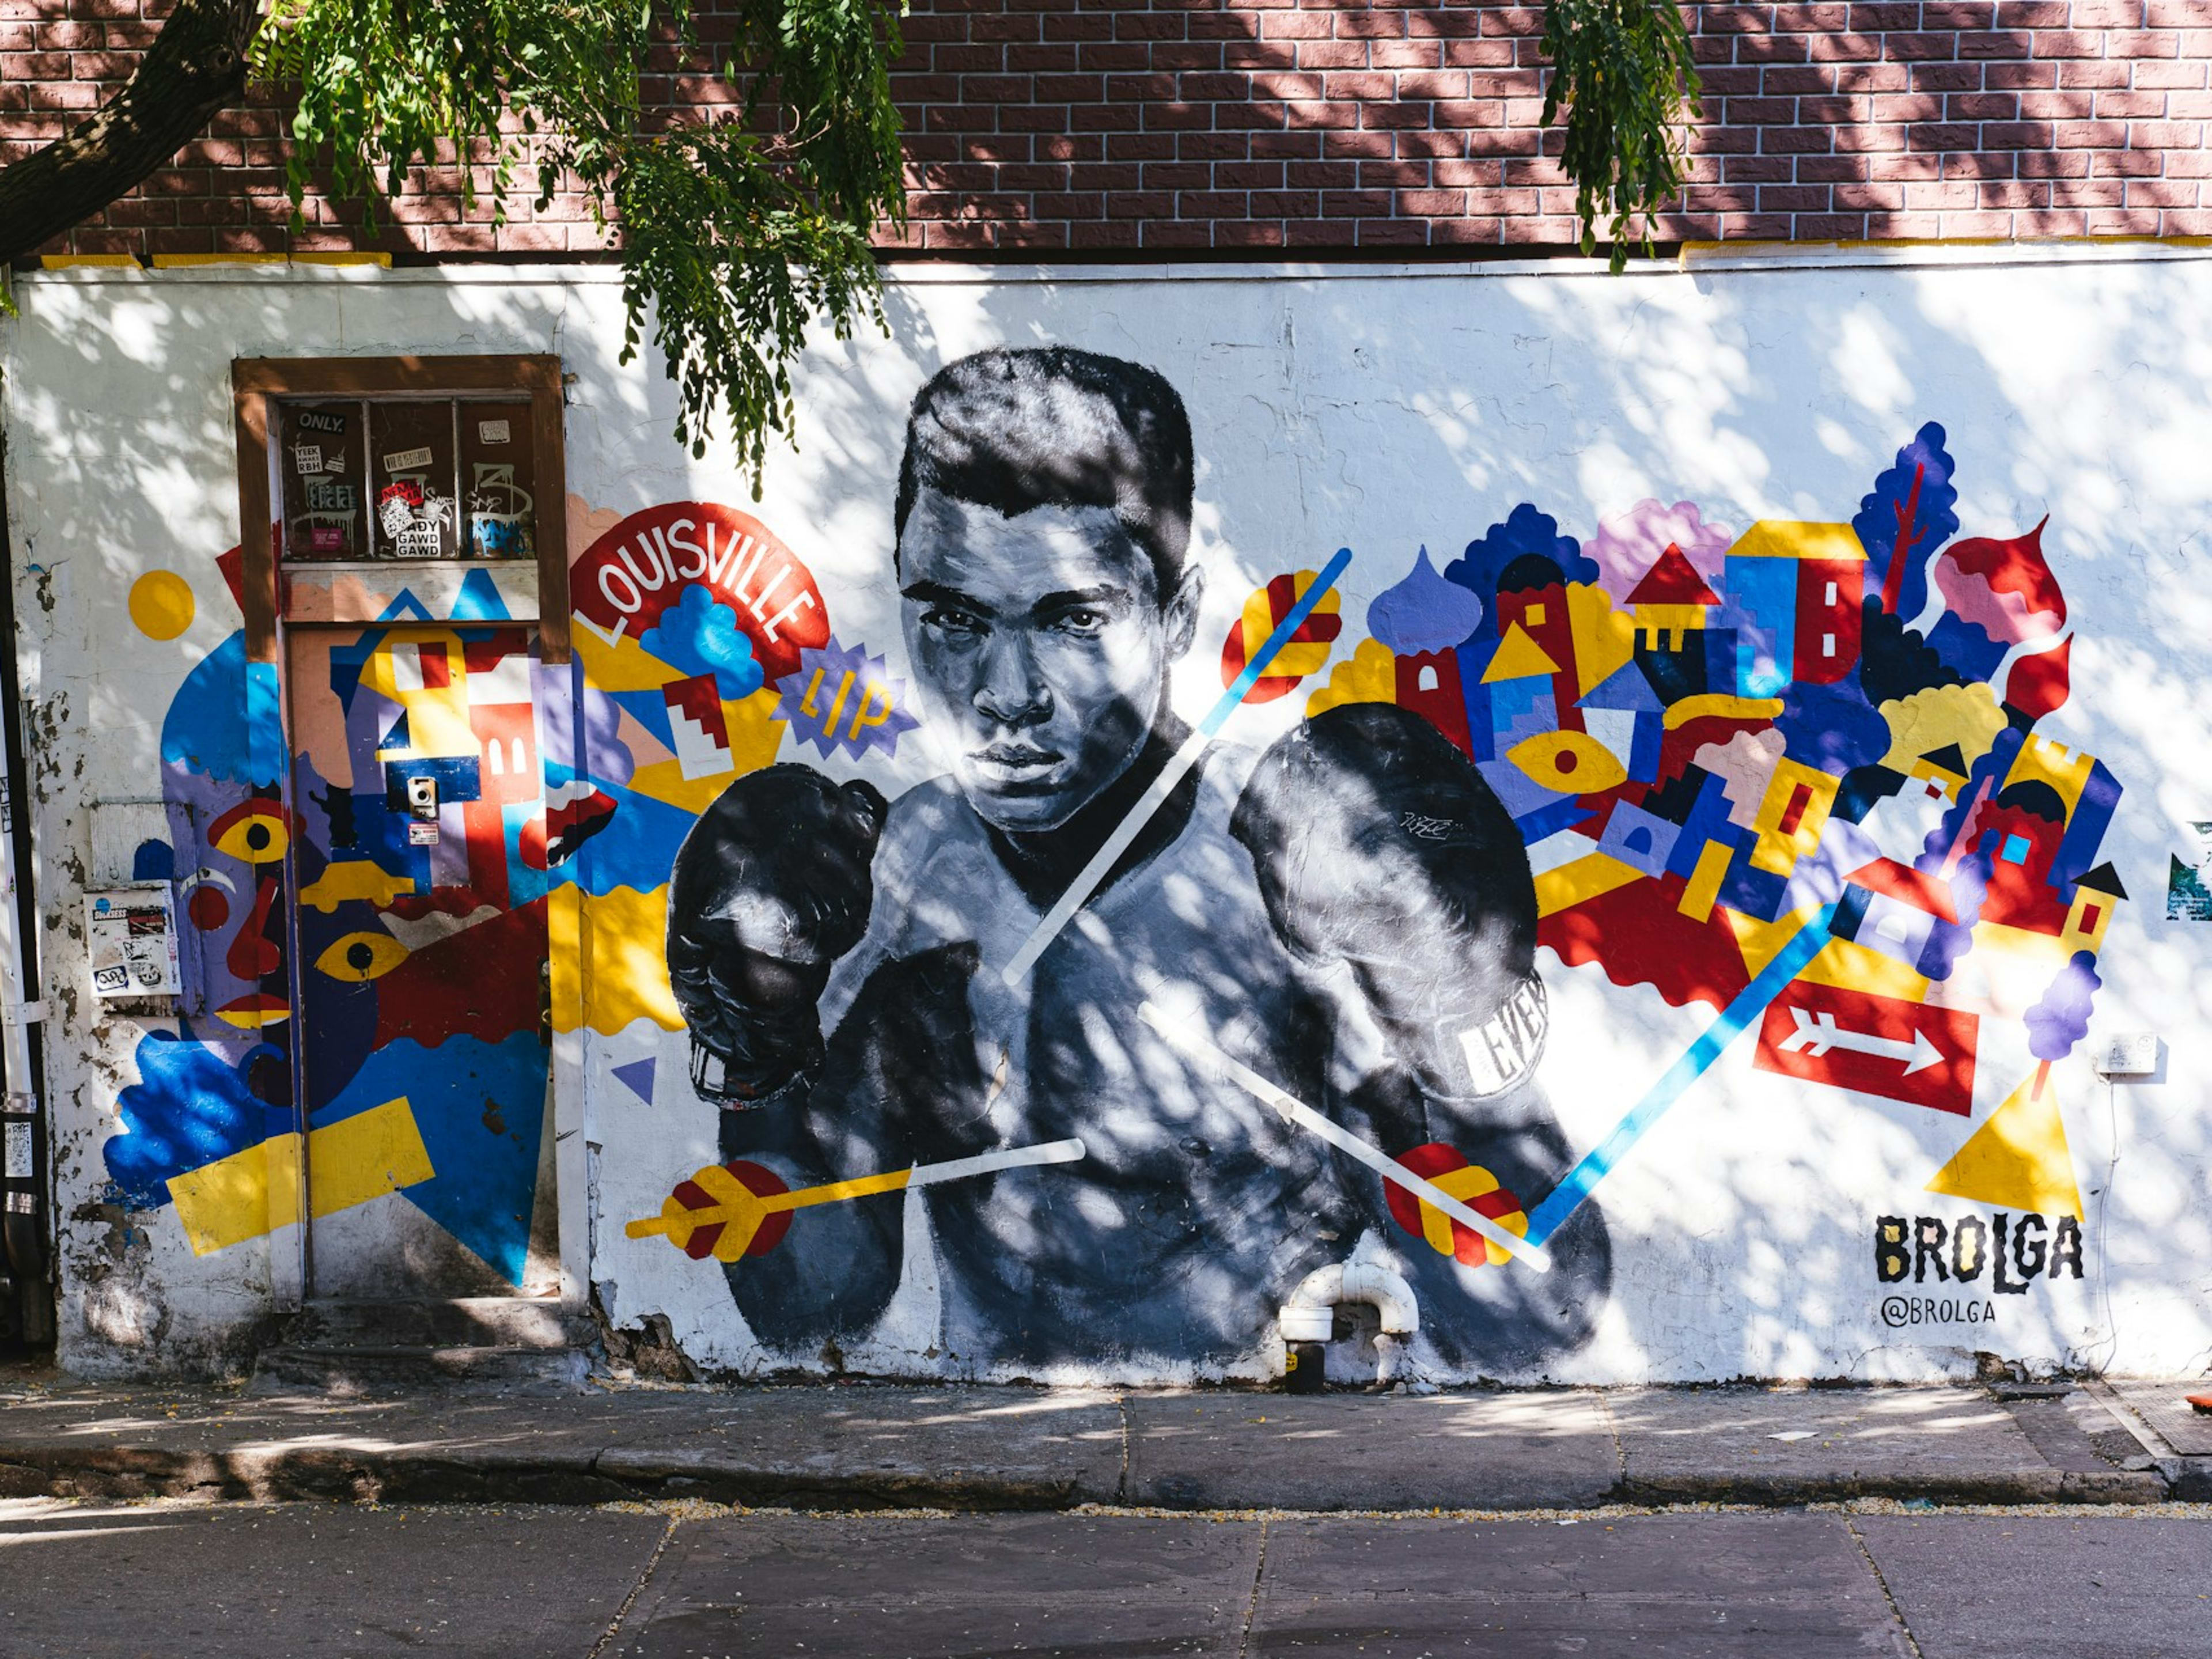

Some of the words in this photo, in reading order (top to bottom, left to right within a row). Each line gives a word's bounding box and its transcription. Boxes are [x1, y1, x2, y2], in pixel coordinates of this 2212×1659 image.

[300, 413, 344, 433] ONLY.
[298, 462, 321, 472] RBH
[403, 521, 438, 532] ADY
[398, 533, 438, 544] GAWD
[398, 546, 438, 555] GAWD
[572, 518, 815, 649] LOUISVILLE
[800, 667, 893, 741] LIP
[1875, 1213, 2084, 1295] BROLGA
[1881, 1296, 1995, 1327] @BROLGA
